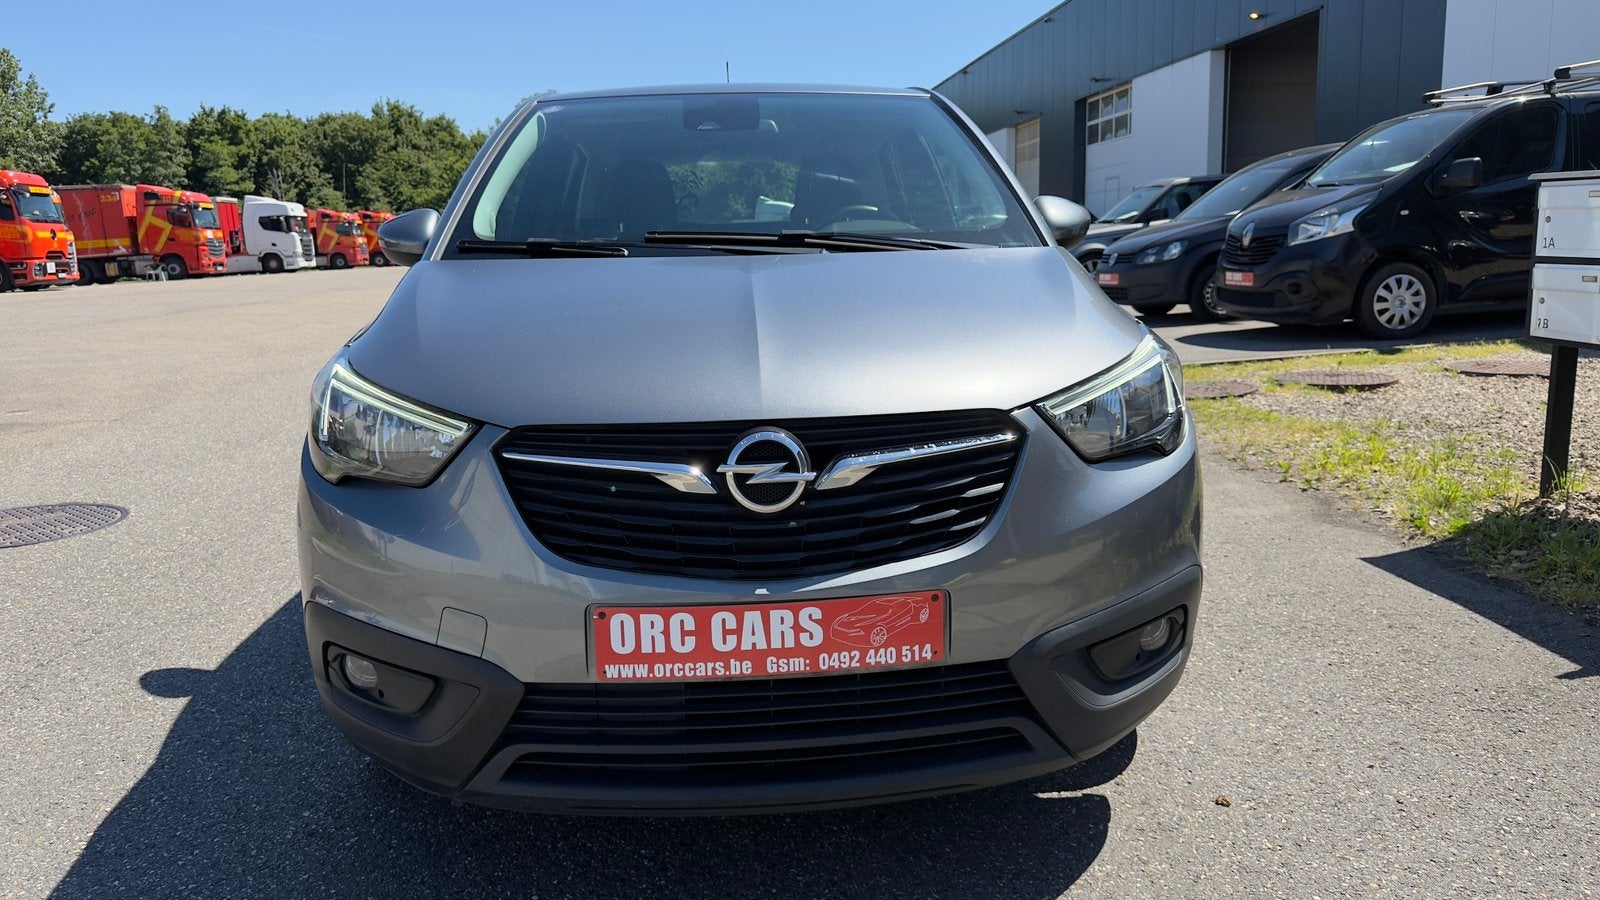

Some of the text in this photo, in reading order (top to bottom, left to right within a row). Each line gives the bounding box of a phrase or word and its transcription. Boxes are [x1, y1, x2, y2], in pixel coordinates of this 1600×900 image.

[1542, 237, 1556, 248] 1A
[609, 607, 824, 655] ORC CARS
[605, 643, 933, 679] www.orccars.be Gsm: 0492 440 514
